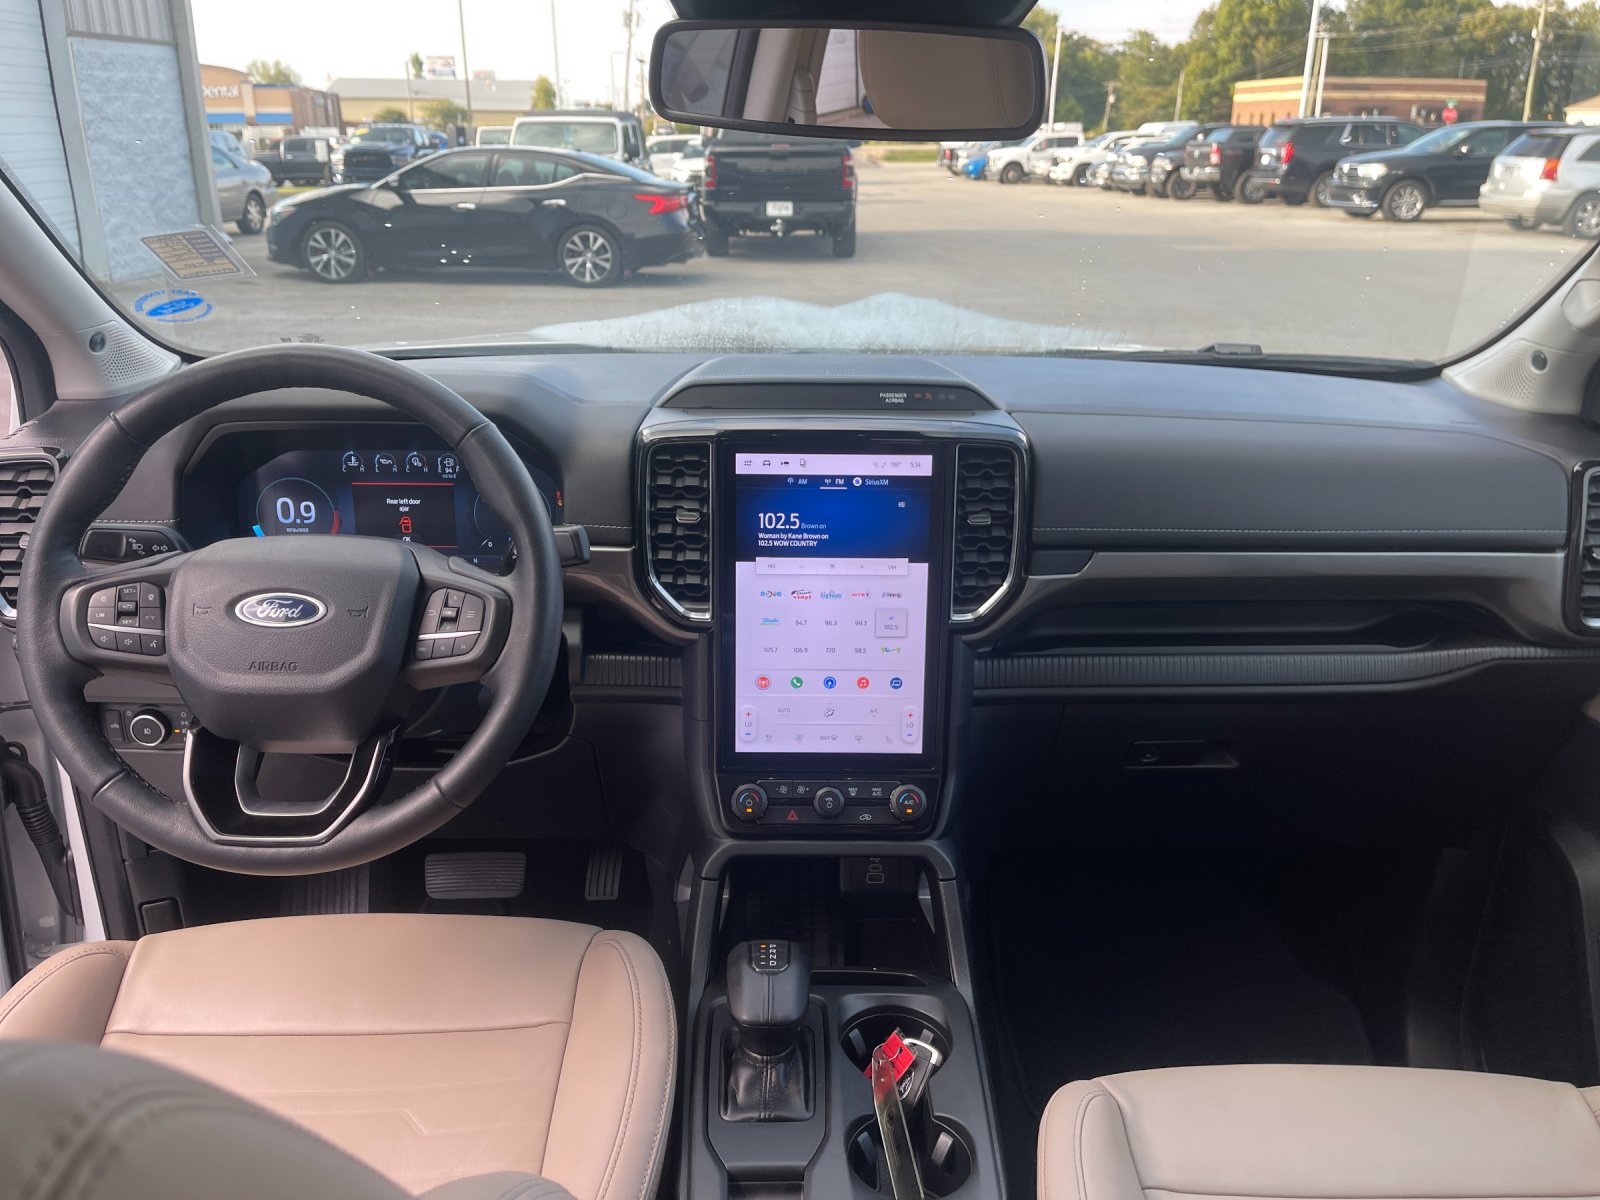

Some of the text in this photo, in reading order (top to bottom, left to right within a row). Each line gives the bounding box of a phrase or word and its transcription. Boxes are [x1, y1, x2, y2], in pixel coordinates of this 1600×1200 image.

[276, 497, 316, 524] 0.9
[758, 513, 800, 529] 102.5
[256, 599, 304, 617] Ford
[249, 661, 298, 671] AIRBAG
